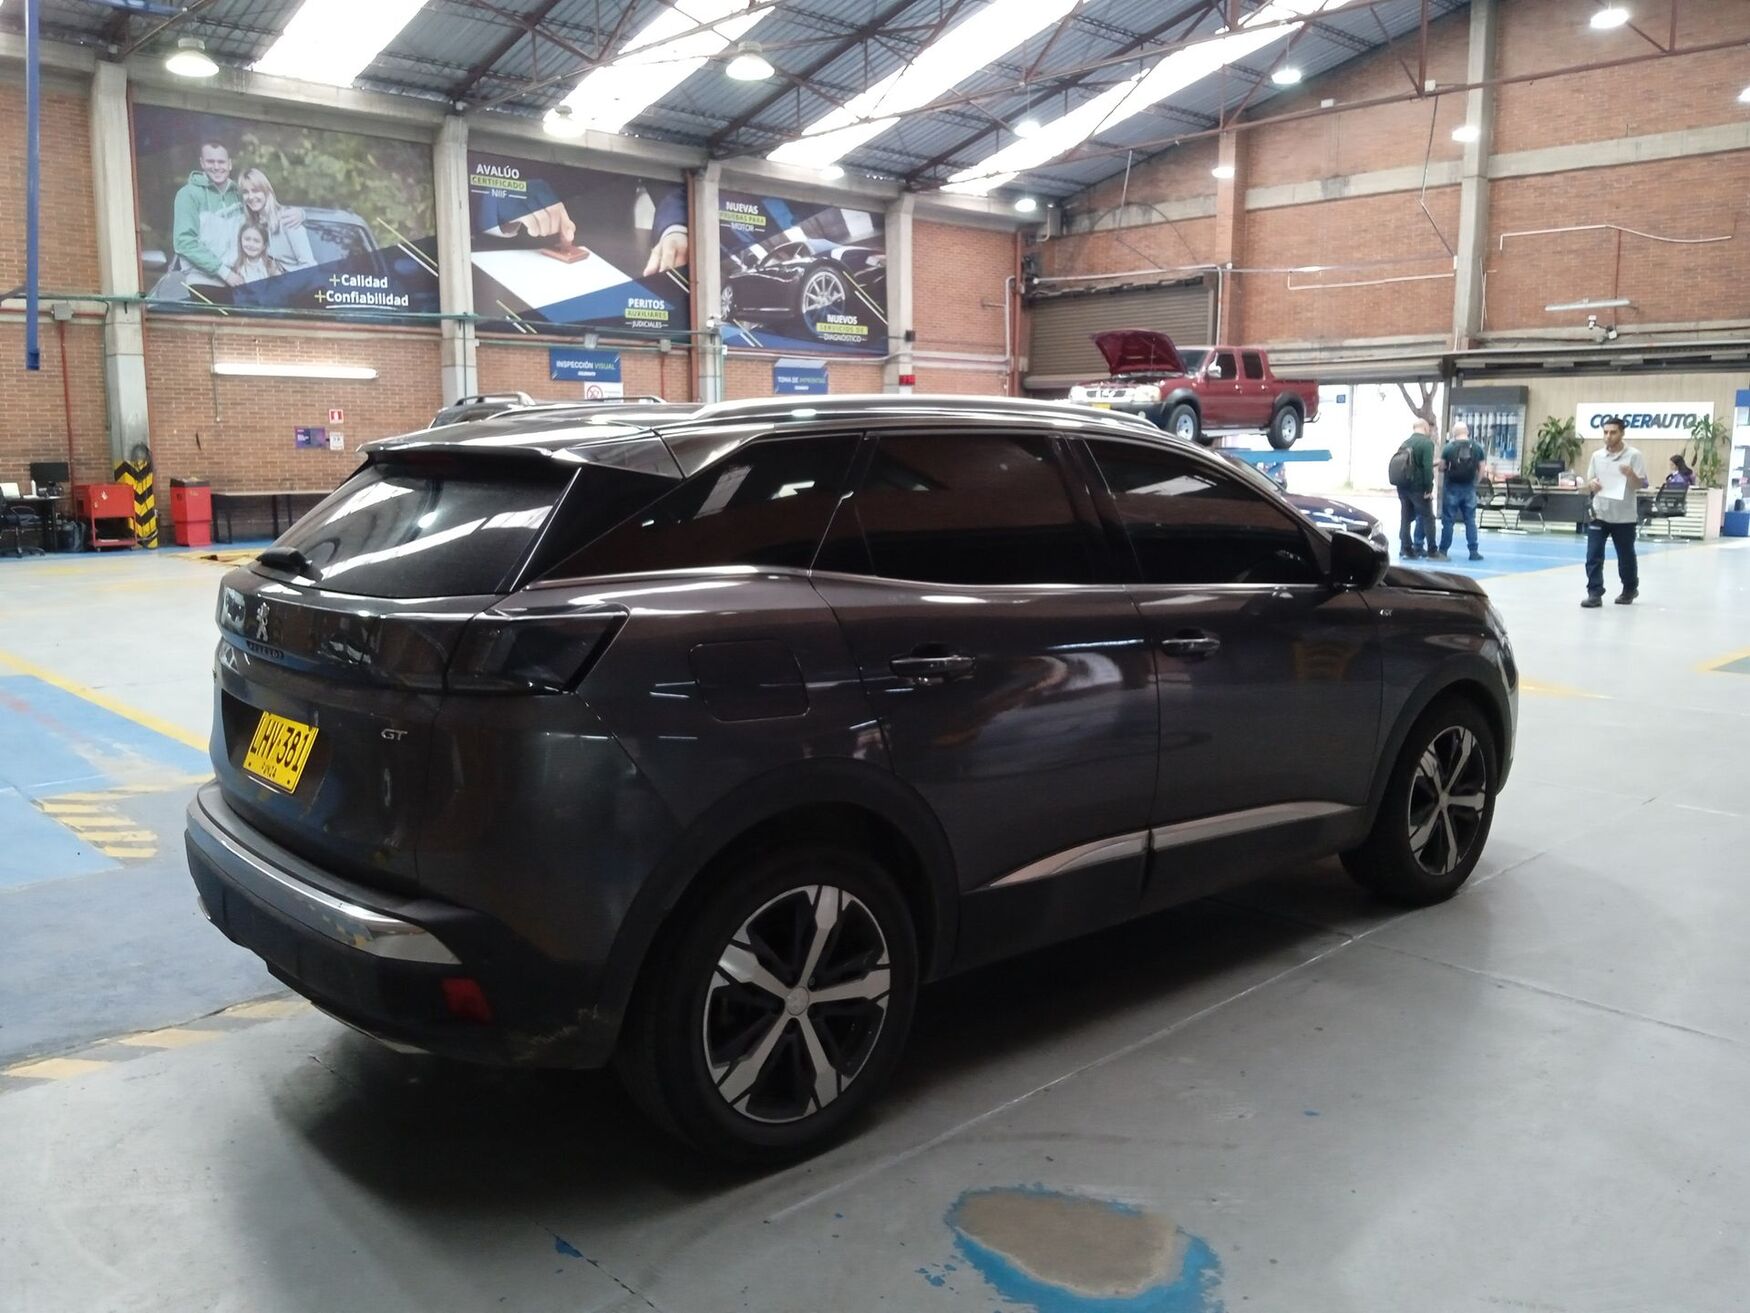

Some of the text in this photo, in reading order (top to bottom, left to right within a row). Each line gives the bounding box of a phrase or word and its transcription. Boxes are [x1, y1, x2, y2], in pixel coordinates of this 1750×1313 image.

[476, 163, 520, 179] AVALÚO
[472, 176, 525, 190] CERTIFICADO
[726, 201, 759, 215] NUEVAS
[628, 298, 665, 310] PERITOS
[627, 309, 667, 320] AUXILIARES
[827, 314, 858, 325] NUEVOS
[632, 321, 662, 329] JUDICIALES
[556, 360, 617, 370] INSPECCIÓN VISUAL
[381, 728, 408, 741] GT
